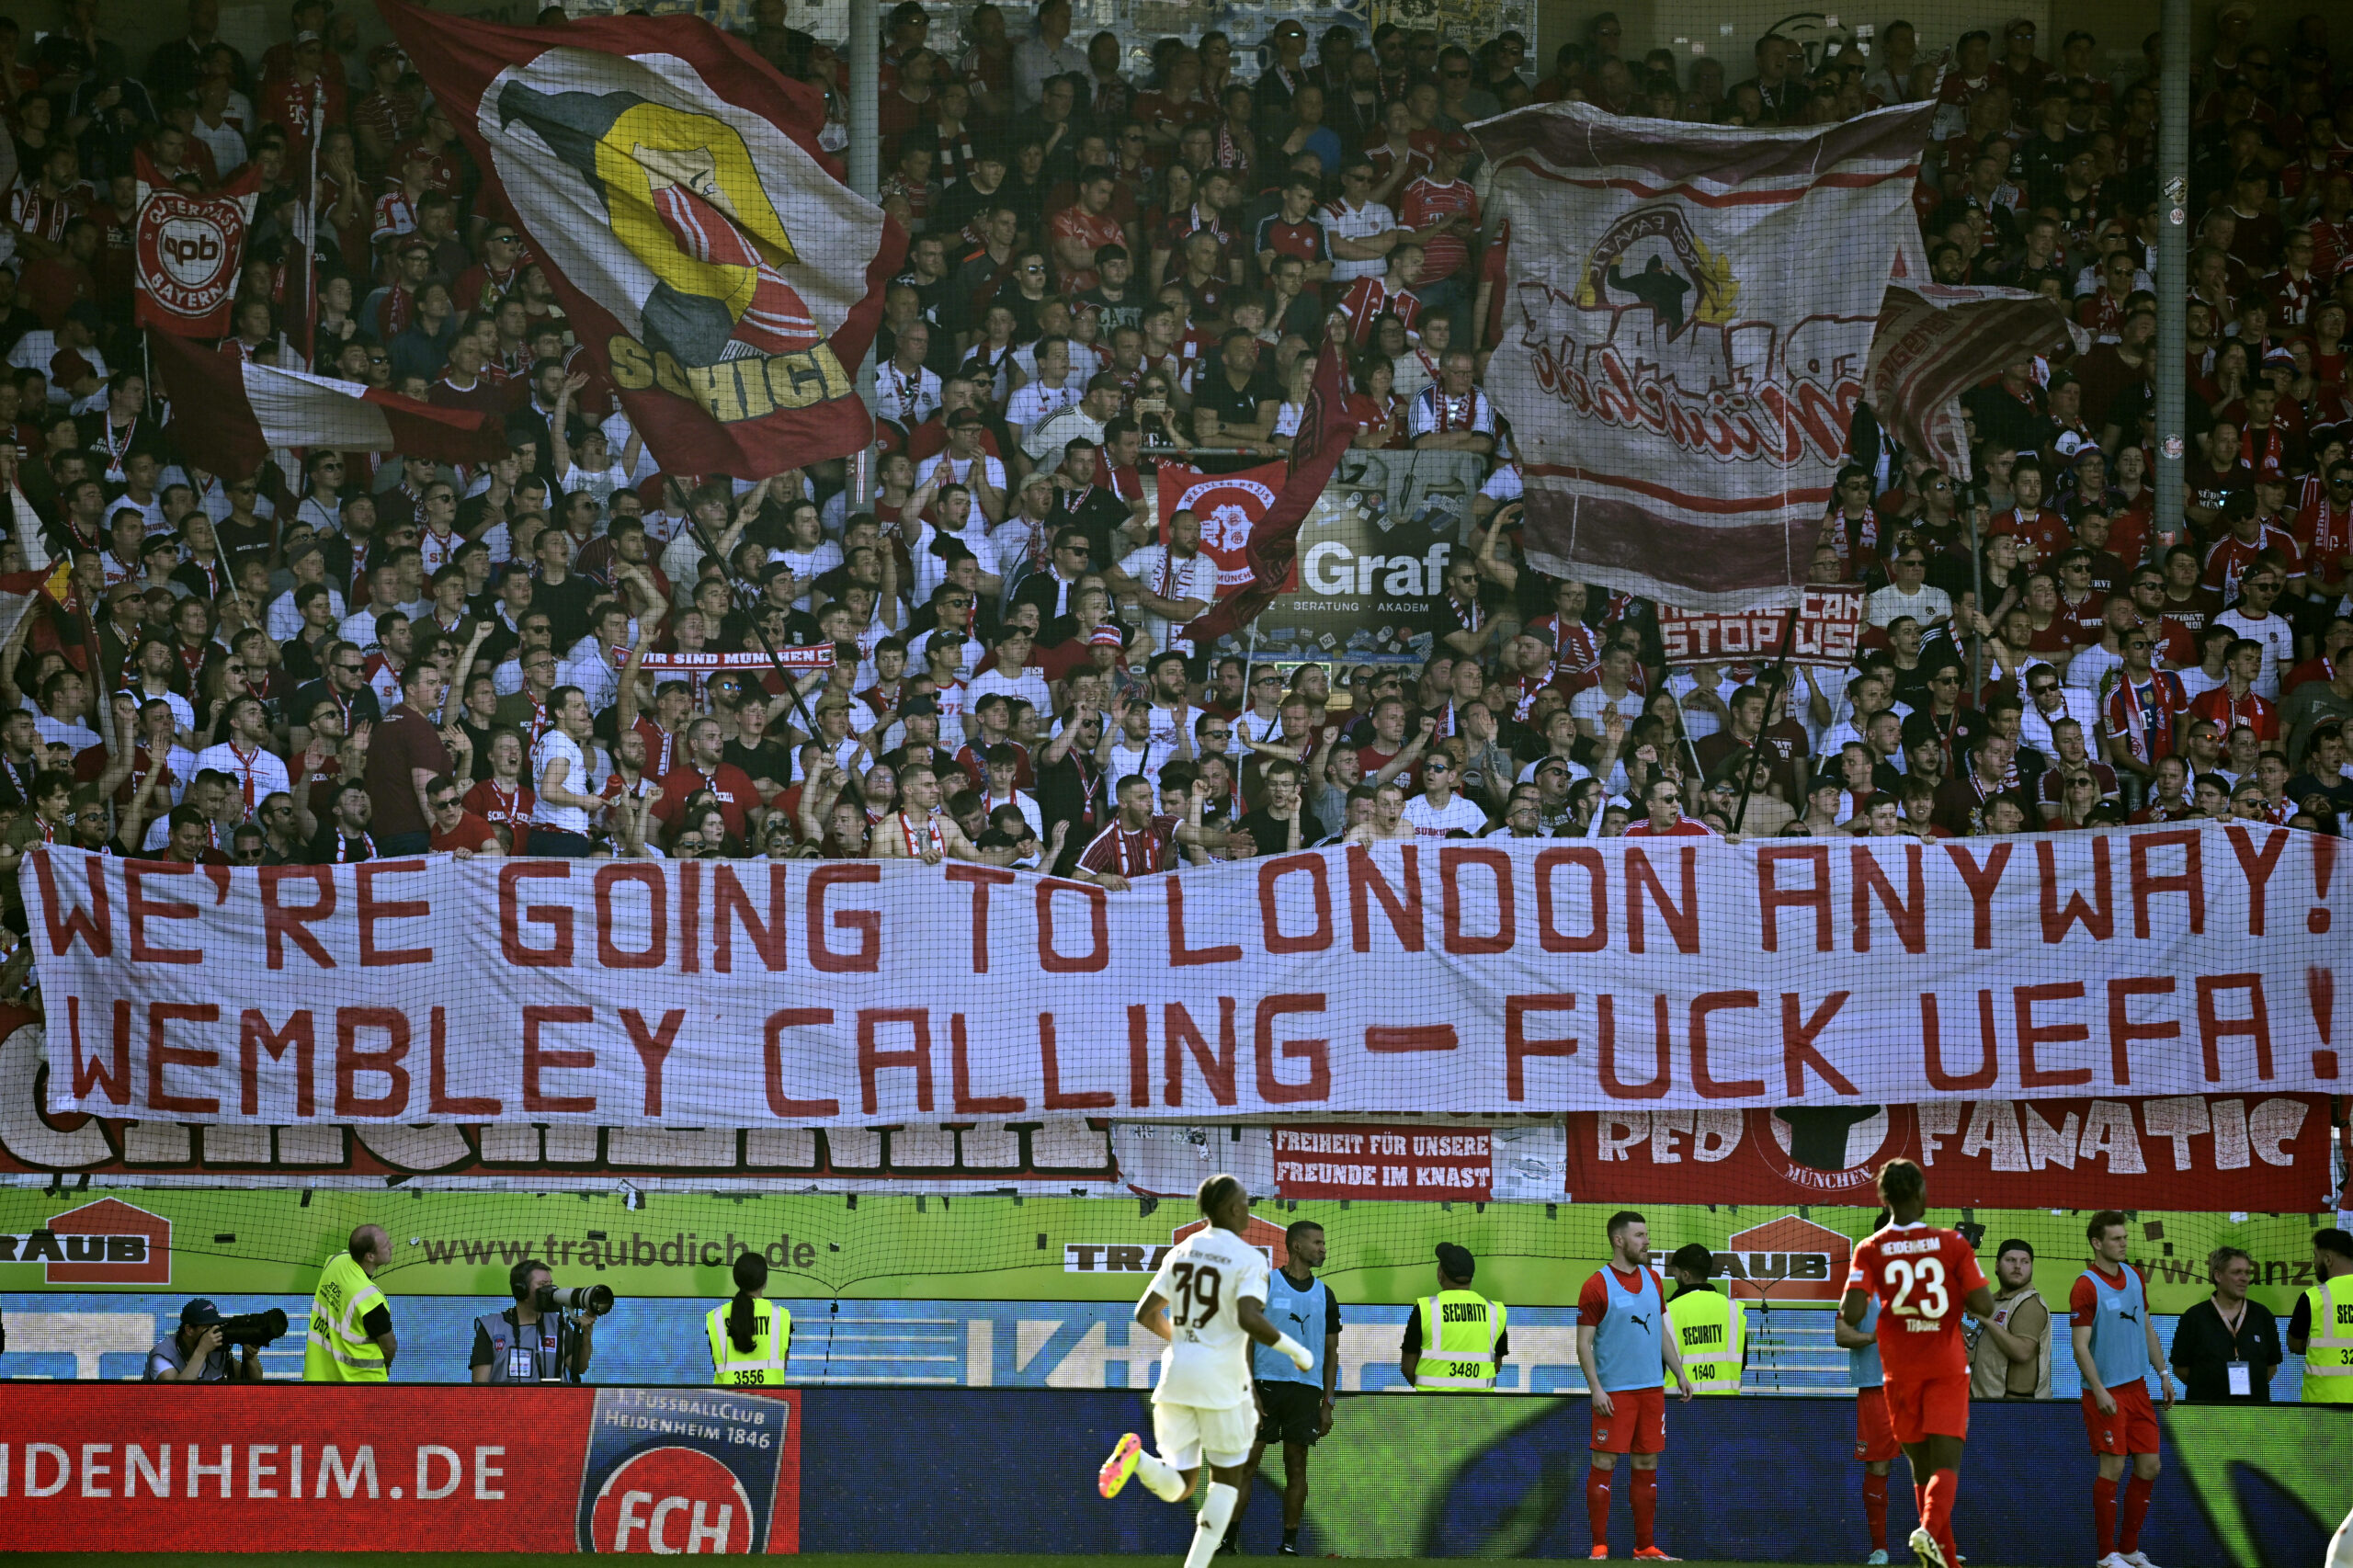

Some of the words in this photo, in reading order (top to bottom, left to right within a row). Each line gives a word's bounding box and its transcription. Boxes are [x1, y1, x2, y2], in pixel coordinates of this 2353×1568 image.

[149, 199, 239, 236] QUEERPASS
[151, 272, 224, 308] BAYERN
[1303, 540, 1450, 597] Graf
[1292, 601, 1360, 612] BERATUNG
[1800, 592, 1864, 620] CAN
[1660, 618, 1779, 658] STOP
[673, 653, 719, 665] SIND
[31, 848, 433, 970] WE'RE
[498, 859, 881, 973] GOING
[945, 863, 1109, 973] TO
[1166, 844, 1700, 967] LONDON
[1756, 825, 2337, 954] ANYWAY!
[66, 995, 686, 1117] WEMBLEY
[763, 1001, 1332, 1117] CALLING
[1505, 990, 1860, 1101] FUCK
[1920, 965, 2339, 1091] UEFA!
[1276, 1130, 1364, 1156] FREIHEIT
[1369, 1130, 1407, 1156] FÜR
[1412, 1133, 1489, 1157] UNSERE
[1597, 1108, 1745, 1165] RED
[1917, 1096, 2309, 1175] FANATIC
[1276, 1161, 1377, 1187] FREUNDE
[1381, 1165, 1409, 1187] IM
[1415, 1165, 1491, 1188] KNAST
[1784, 1162, 1878, 1189] MÜNCHEN
[1171, 1262, 1222, 1329] 39
[1884, 1256, 1949, 1319] 23
[1442, 1302, 1487, 1323] SECURITY
[1682, 1324, 1722, 1346] SECURITY
[733, 1369, 765, 1386] 3556
[1449, 1362, 1480, 1378] 3480
[1692, 1363, 1716, 1381] 1640
[728, 1426, 771, 1449] 1846
[613, 1489, 733, 1554] FCH
